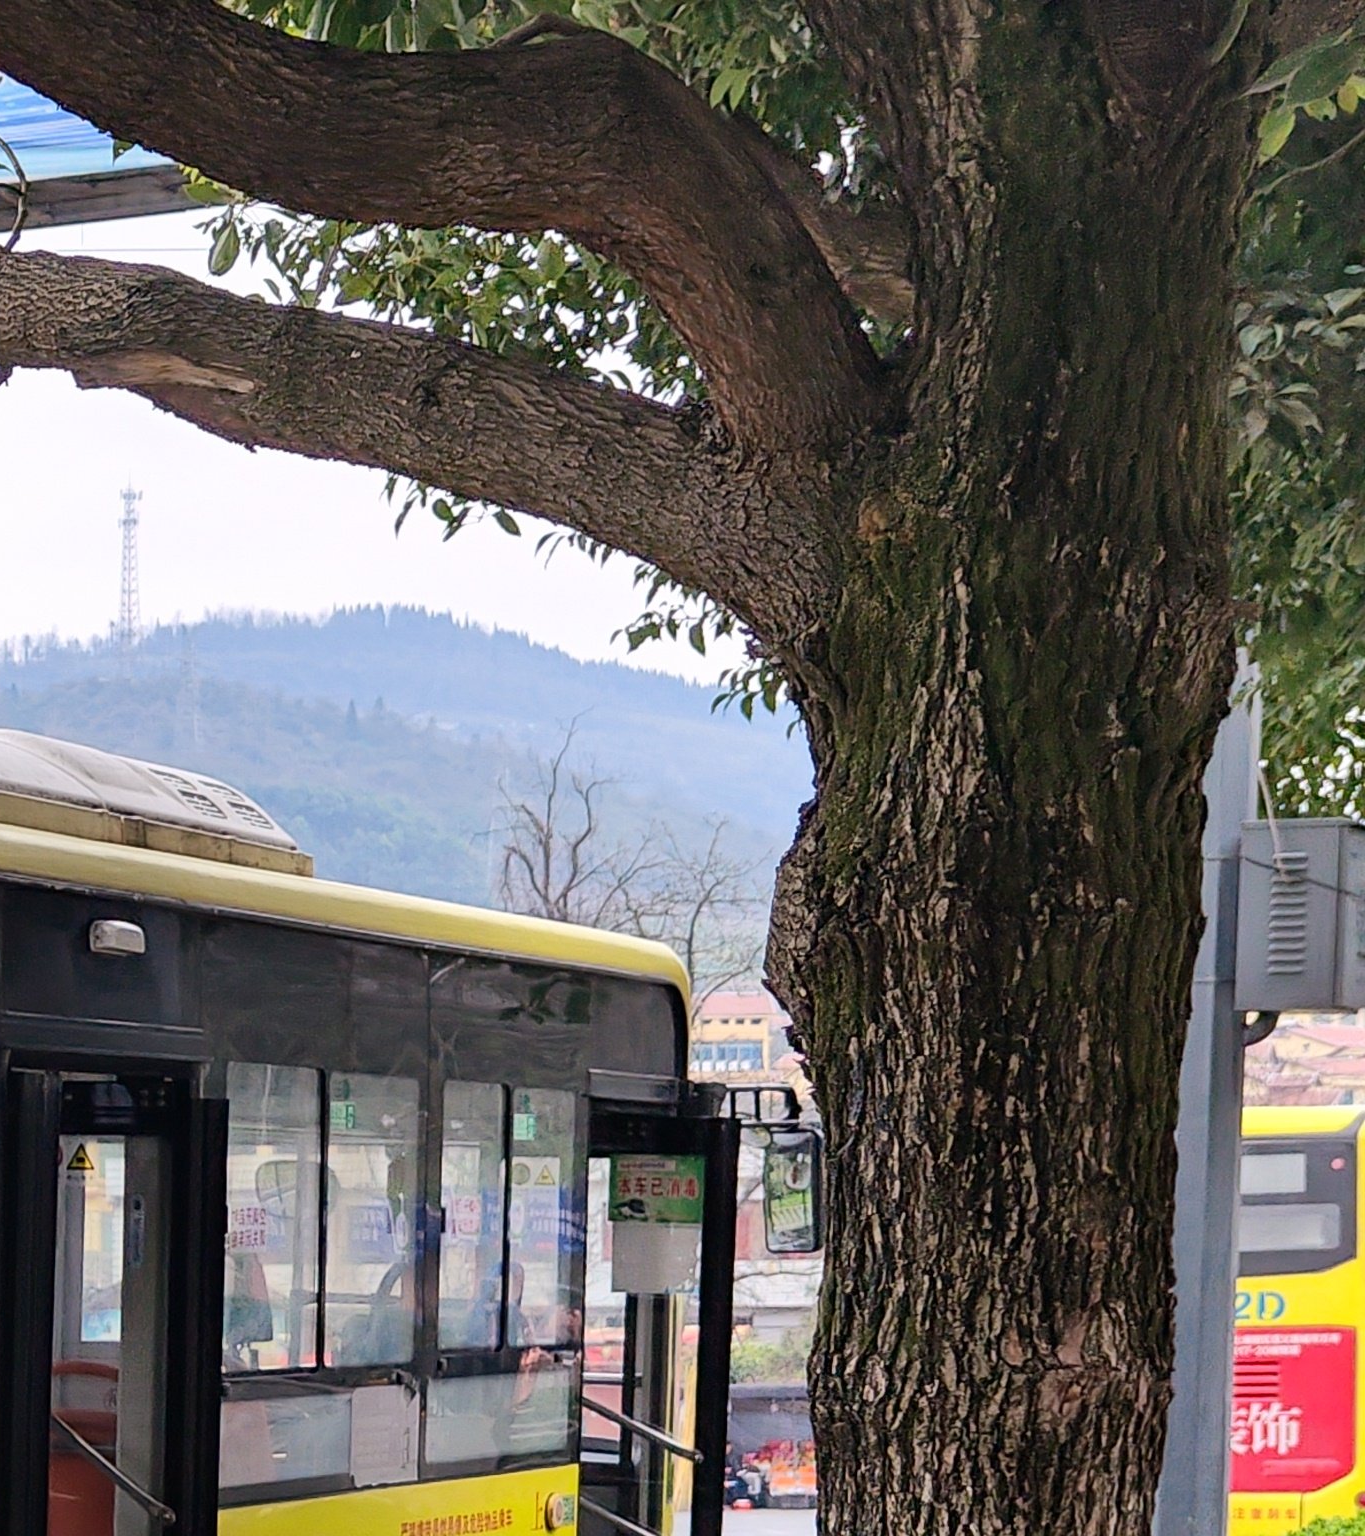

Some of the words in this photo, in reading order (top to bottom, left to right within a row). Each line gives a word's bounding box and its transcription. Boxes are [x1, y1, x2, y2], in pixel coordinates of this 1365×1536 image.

[618, 1175, 698, 1199] 本车已消毒
